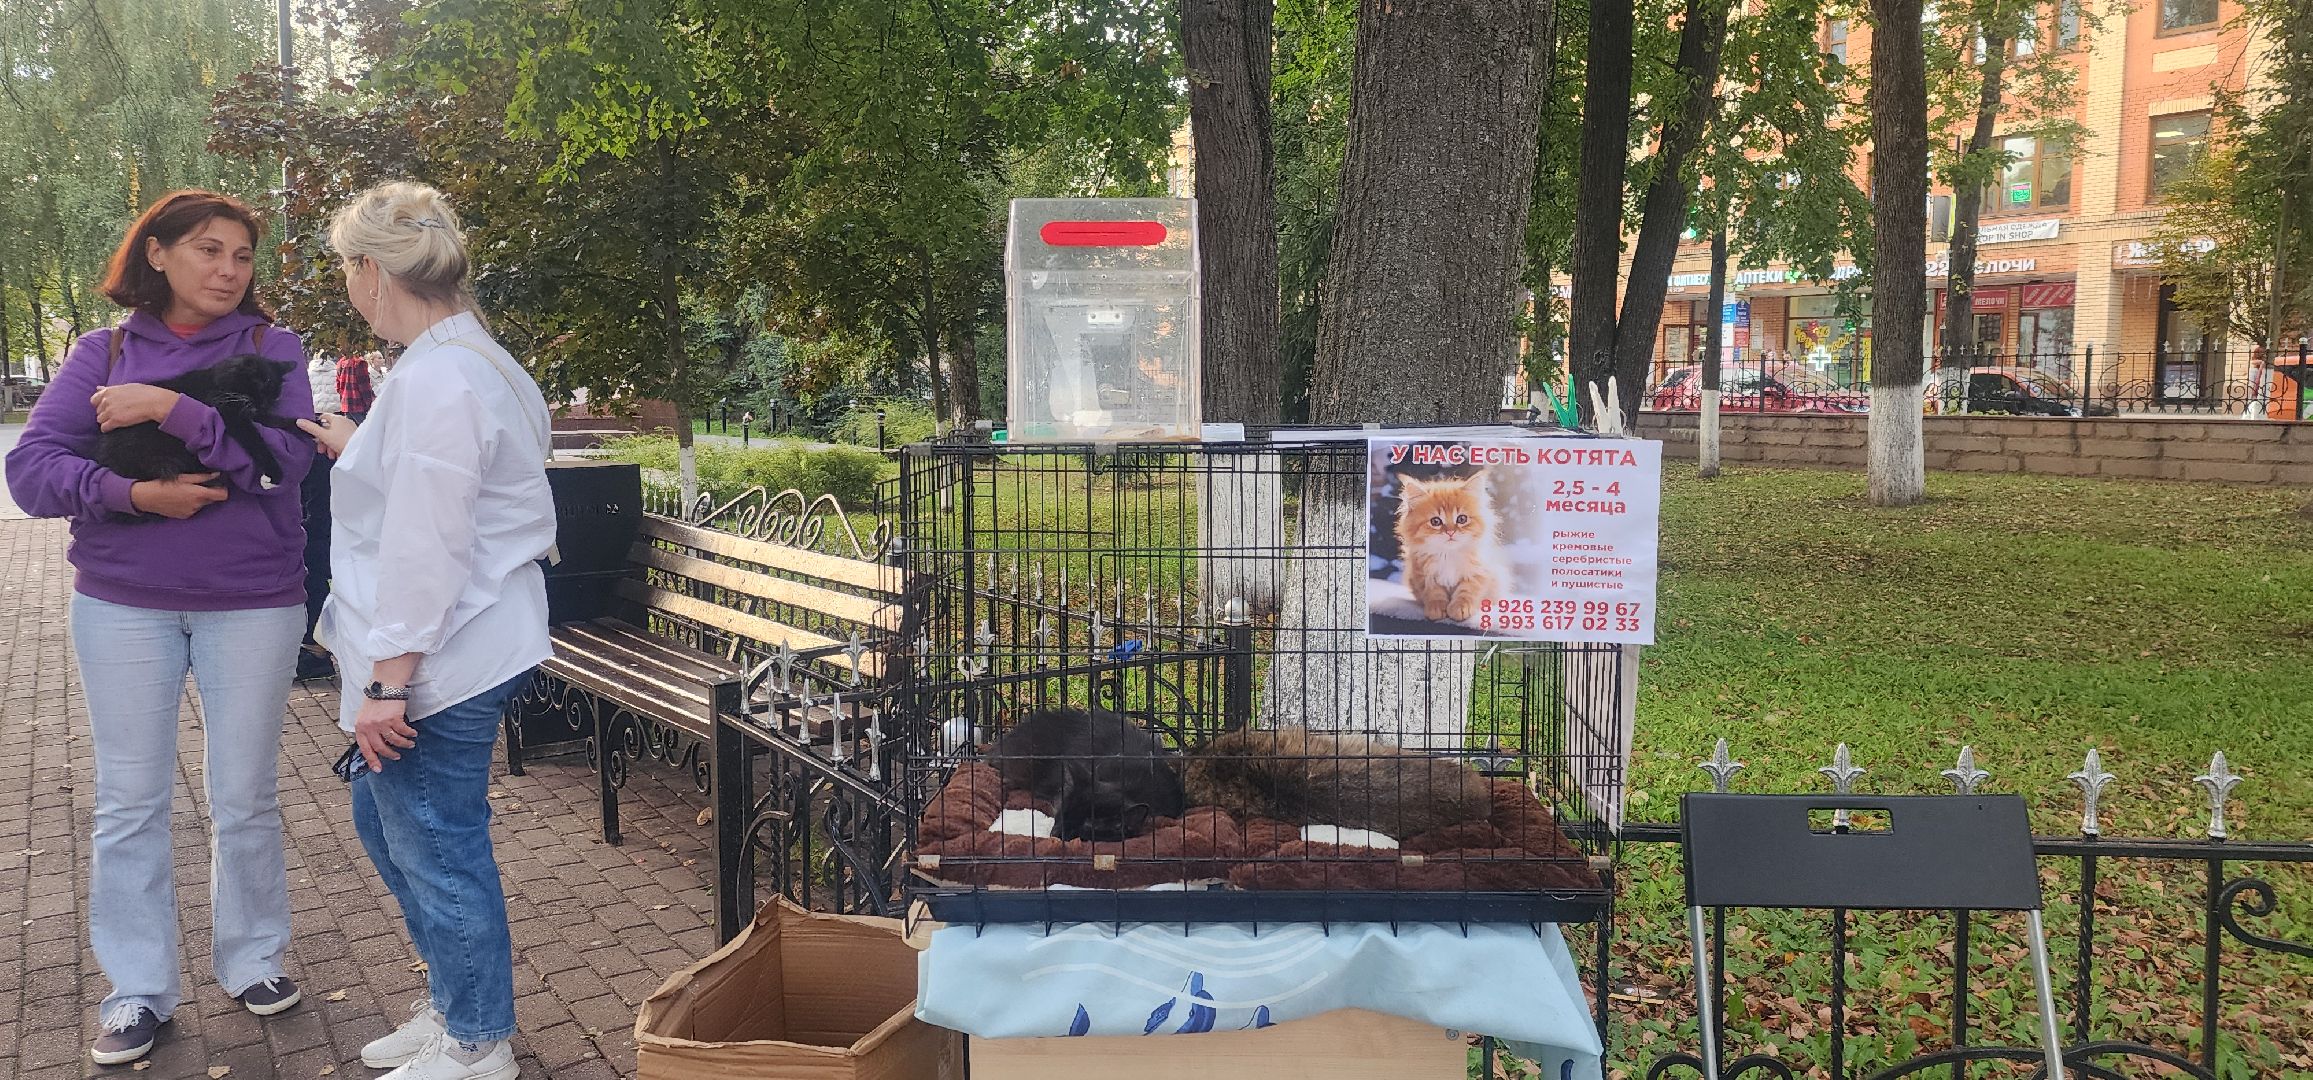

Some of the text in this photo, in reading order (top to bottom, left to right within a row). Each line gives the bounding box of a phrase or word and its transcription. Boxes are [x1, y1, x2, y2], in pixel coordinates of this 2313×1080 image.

[1735, 270, 1783, 284] АПТЕКИ
[1391, 444, 1637, 467] У НАС ЕСТЬ КОТЯТА
[1553, 480, 1585, 498] 2,5
[1606, 481, 1621, 496] 4
[1545, 500, 1626, 515] месяца
[1552, 530, 1596, 539] рыжие
[1552, 543, 1614, 552] кремовые
[1552, 555, 1633, 565] серебристые
[1551, 568, 1623, 577] полосатики
[1561, 580, 1624, 589] пушистые
[1480, 599, 1641, 616] 8 926 239 99 67
[1480, 615, 1640, 631] 8 993 617 02 33
